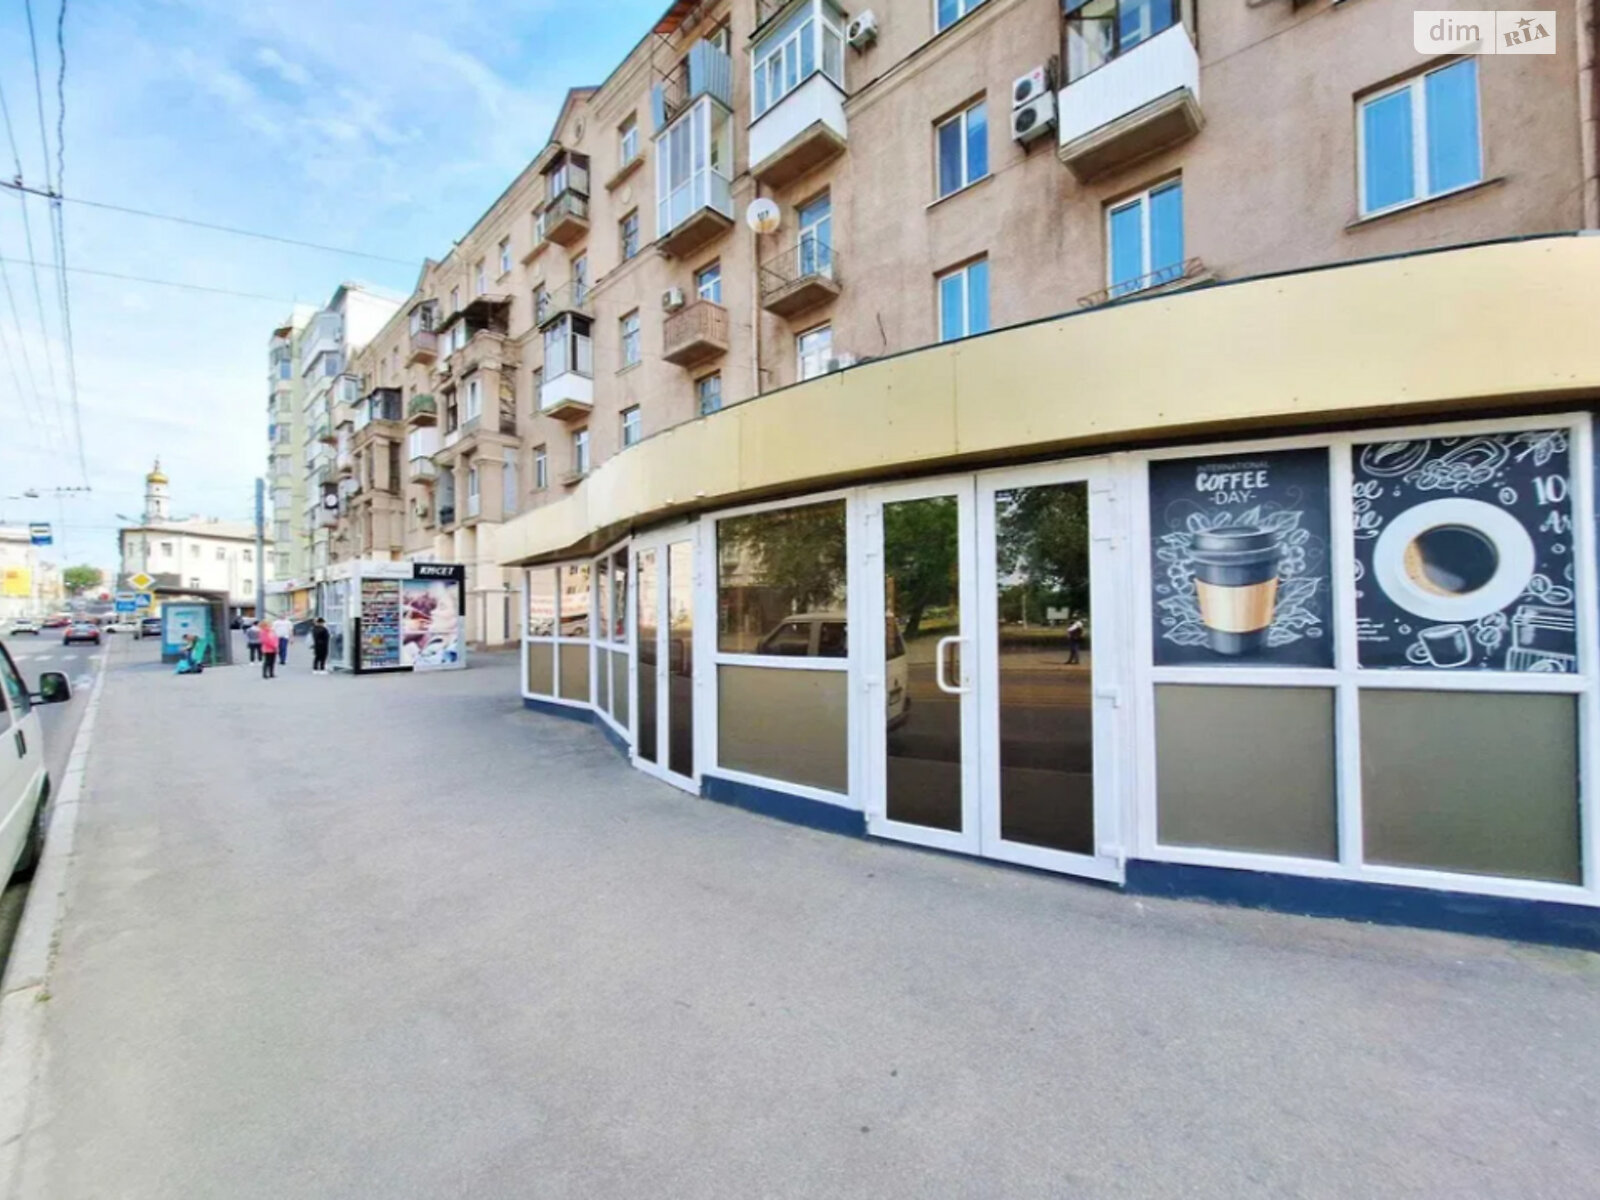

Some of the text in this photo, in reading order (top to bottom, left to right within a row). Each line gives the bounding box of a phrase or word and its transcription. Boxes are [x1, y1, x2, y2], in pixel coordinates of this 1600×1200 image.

[1196, 461, 1271, 473] INTERNATIONAL
[1195, 470, 1270, 492] COFFEE
[1530, 474, 1570, 506] 10
